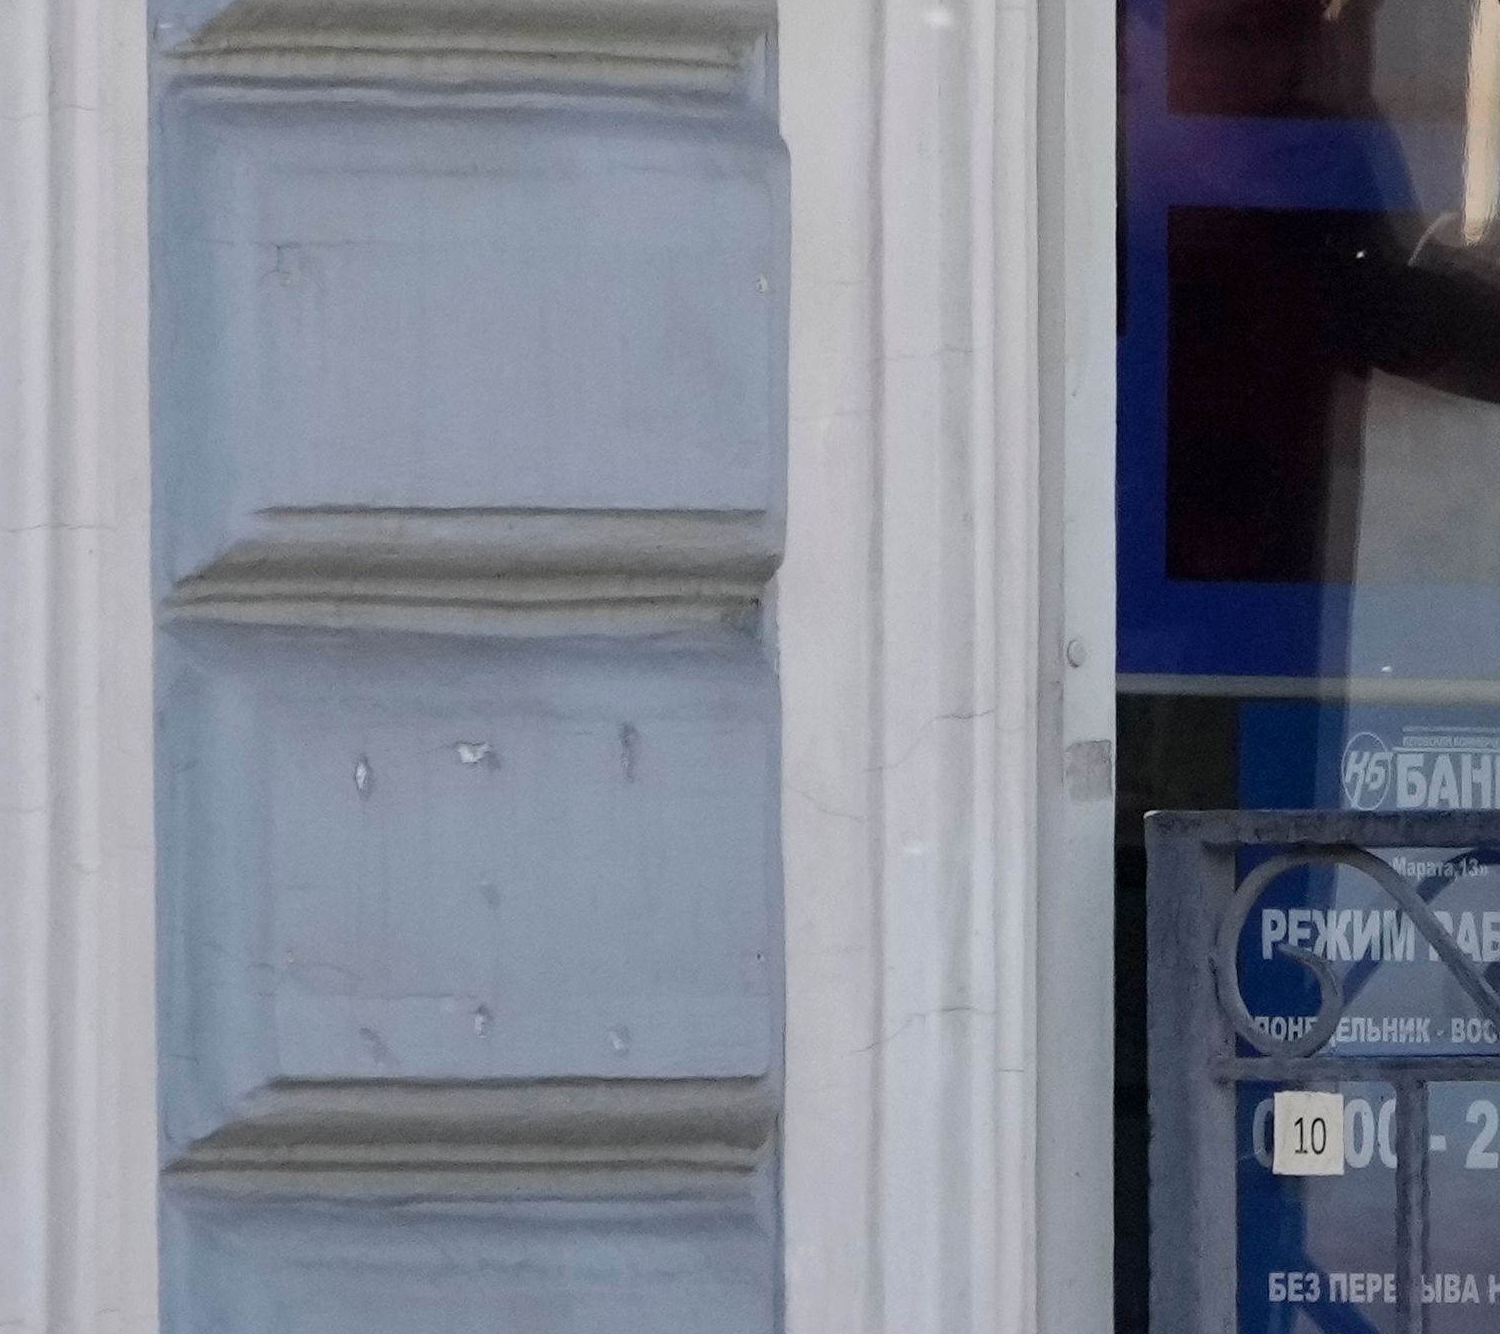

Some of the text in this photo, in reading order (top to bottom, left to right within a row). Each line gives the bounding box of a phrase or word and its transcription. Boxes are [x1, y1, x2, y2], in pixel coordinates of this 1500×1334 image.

[1261, 907, 1415, 962] РЕЖИМ
[1253, 1015, 1431, 1048] ПОНЕЕЛЬНИК
[1293, 1116, 1328, 1156] 10
[1268, 1272, 1321, 1304] БЕЗ
[1329, 1272, 1480, 1304] ПЕРЕЫВА
